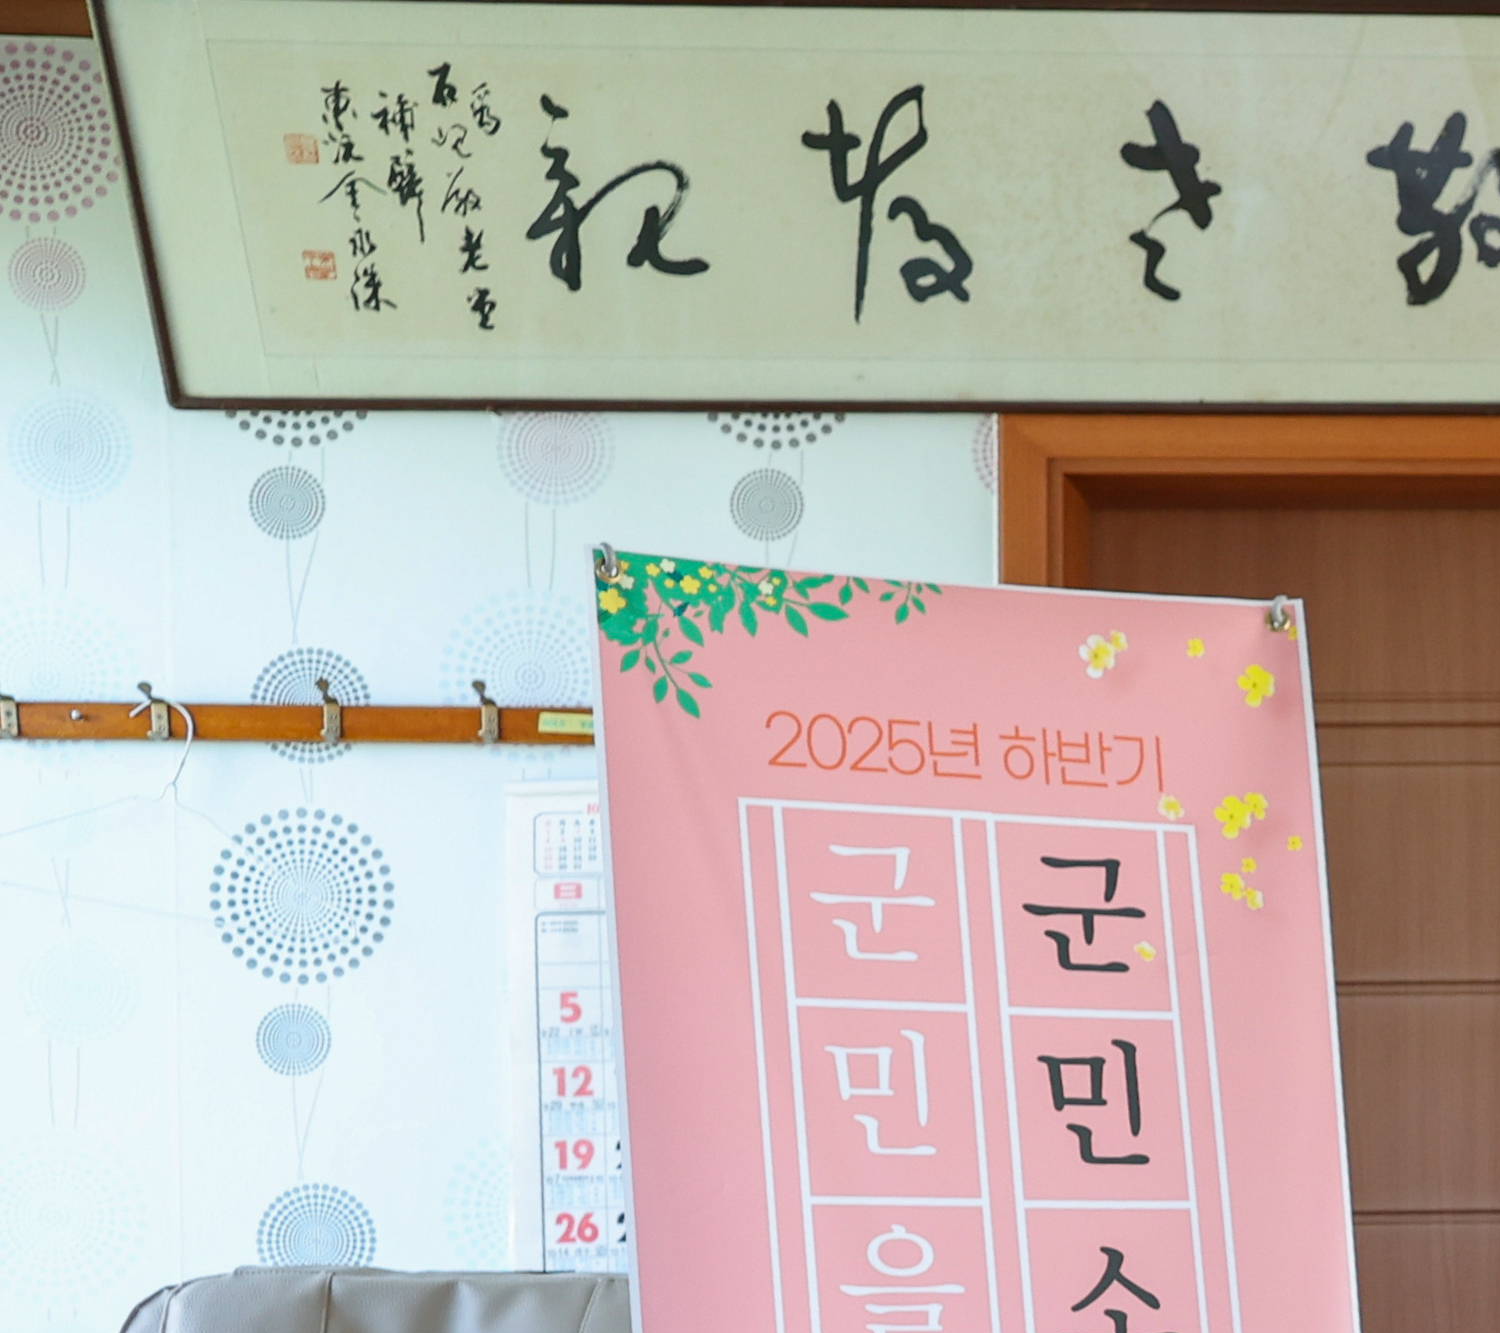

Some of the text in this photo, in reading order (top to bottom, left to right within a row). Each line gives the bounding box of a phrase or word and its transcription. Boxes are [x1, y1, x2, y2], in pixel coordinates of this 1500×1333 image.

[764, 709, 1166, 793] 2025년 하반기
[559, 991, 583, 1025] 5
[552, 1065, 595, 1098] 12
[554, 1138, 596, 1171] 19
[555, 1211, 600, 1244] 26
